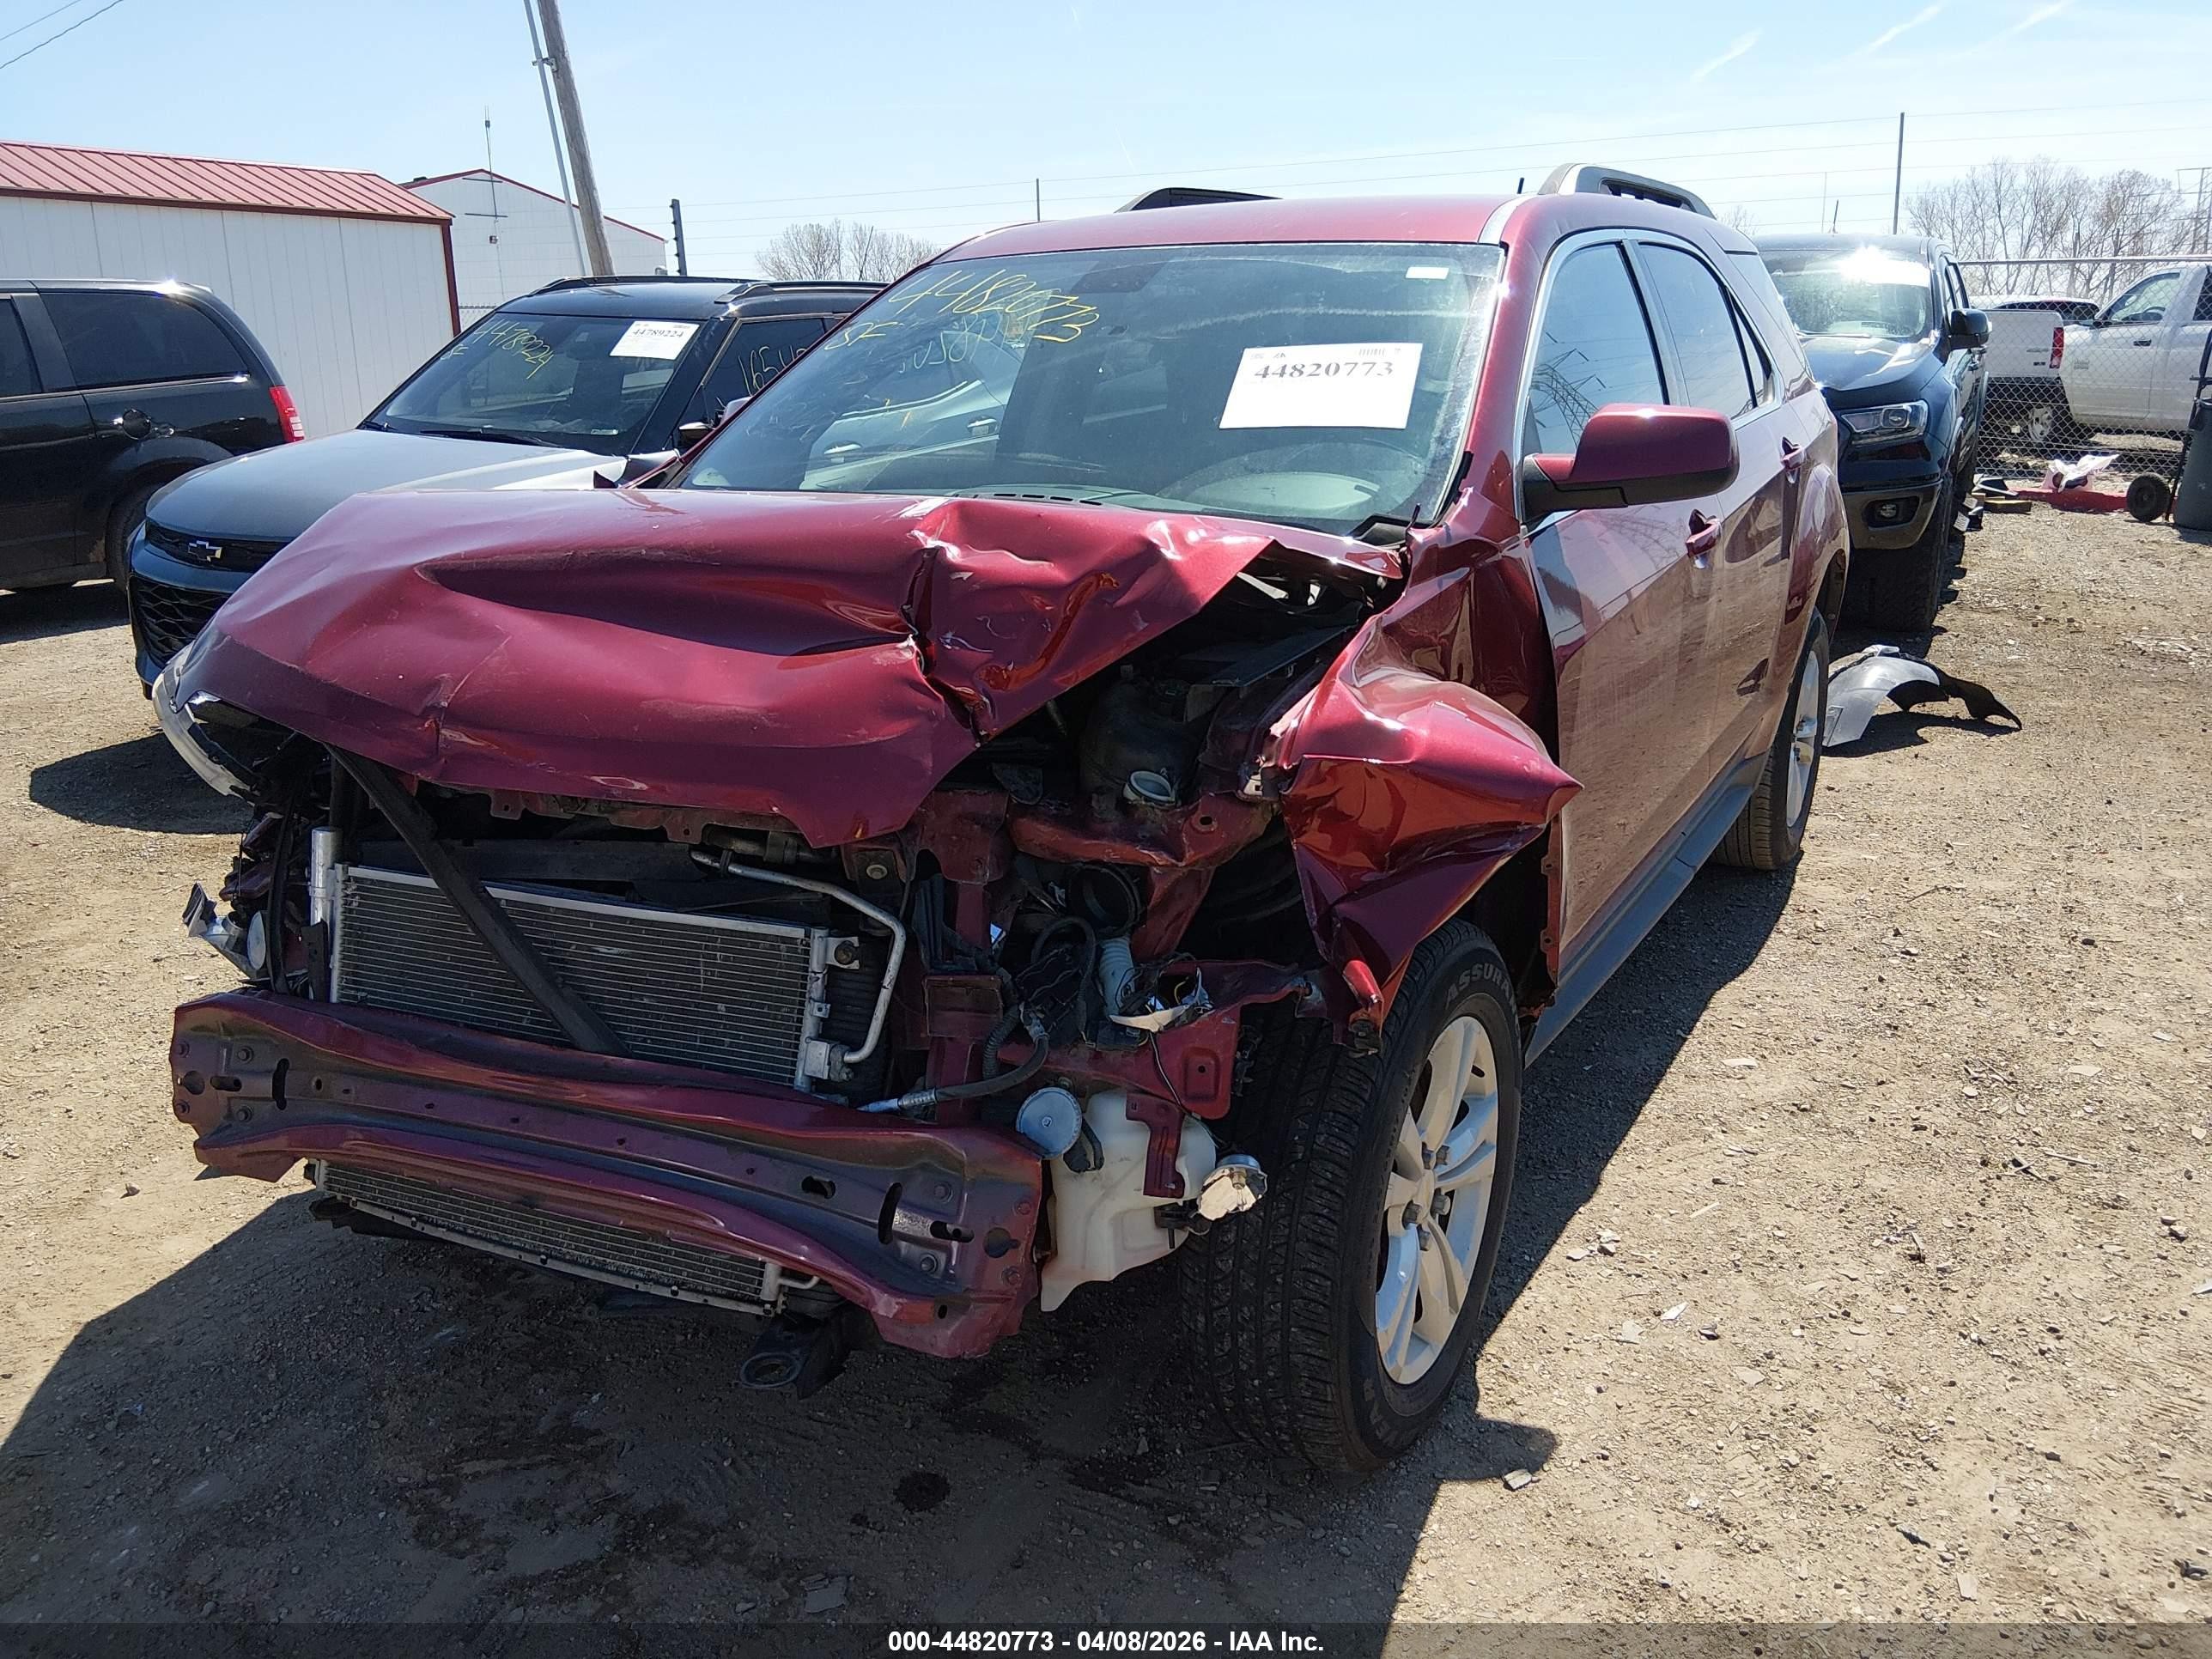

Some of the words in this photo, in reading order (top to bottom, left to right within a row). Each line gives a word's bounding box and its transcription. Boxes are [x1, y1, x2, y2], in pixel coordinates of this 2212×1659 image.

[888, 268, 1100, 343] 44820773
[631, 328, 685, 338] 44789224
[1255, 362, 1395, 379] 44820773
